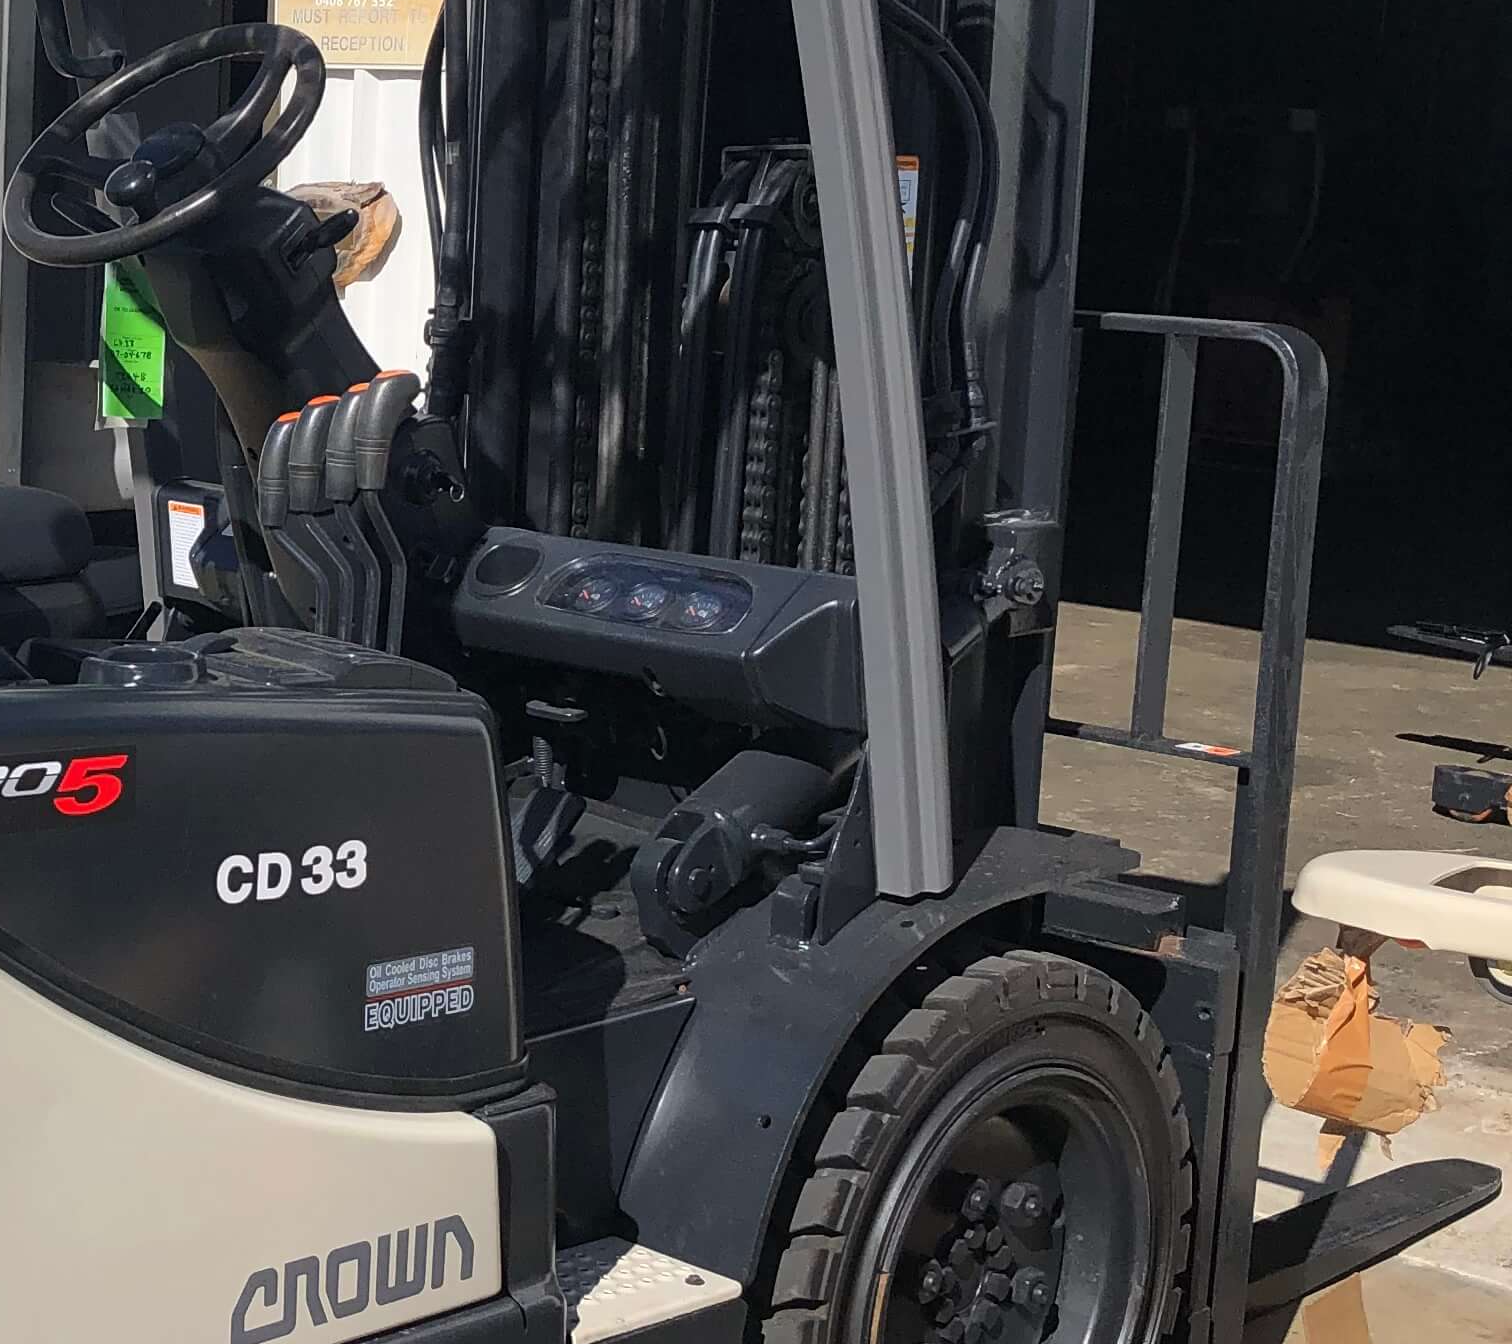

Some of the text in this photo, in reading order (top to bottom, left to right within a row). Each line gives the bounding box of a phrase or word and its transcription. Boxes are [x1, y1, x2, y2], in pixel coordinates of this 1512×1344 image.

[292, 8, 331, 24] MUST
[320, 35, 406, 53] RECEPTION
[216, 839, 369, 905] CD 33
[369, 950, 472, 979] Oil Cooled Disc Brakes
[369, 963, 472, 995] Operator Sensing System
[364, 984, 474, 1032] EQUIPPED
